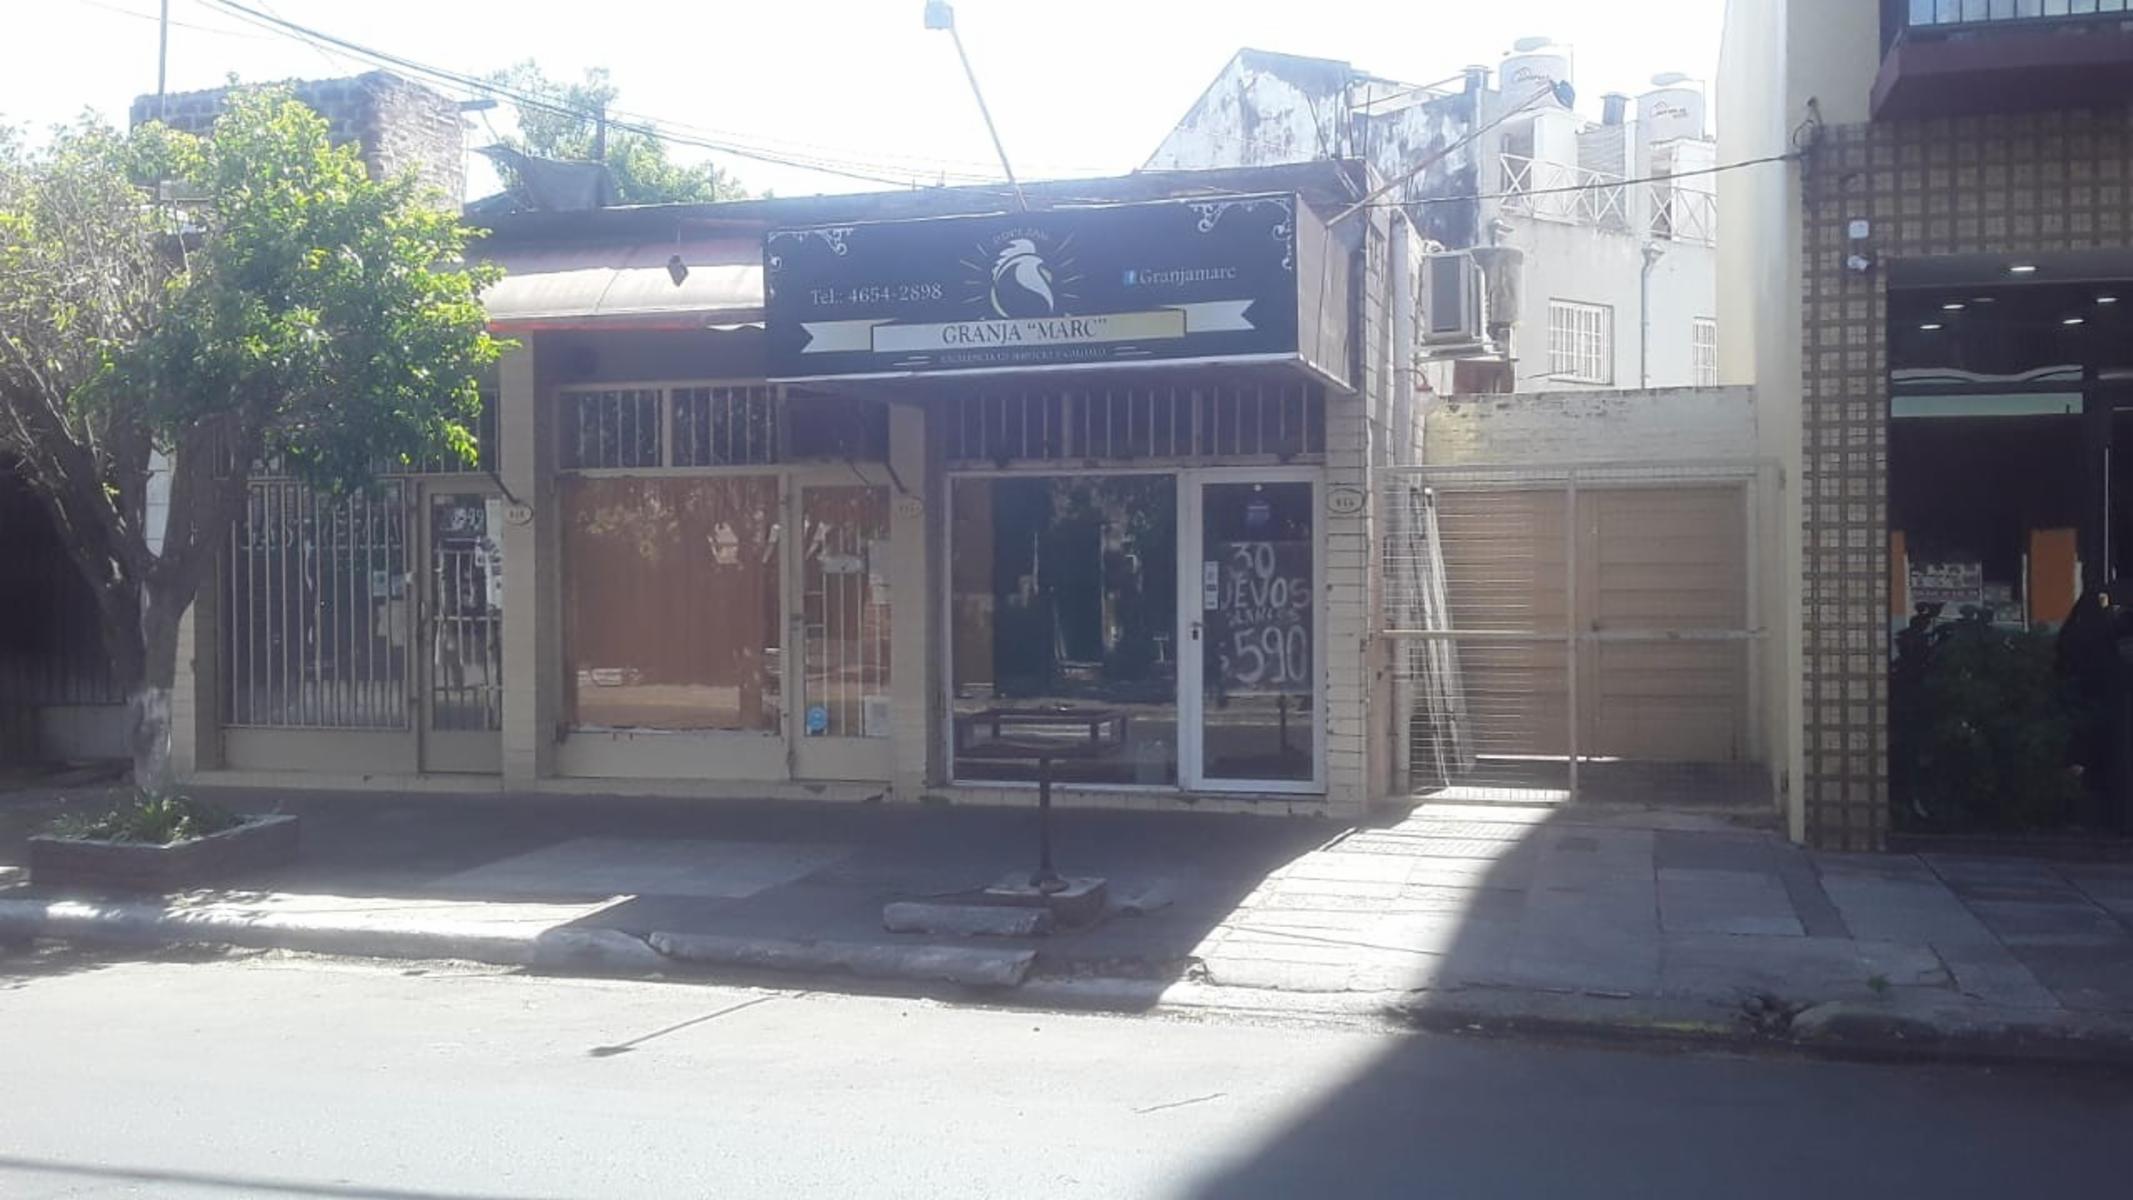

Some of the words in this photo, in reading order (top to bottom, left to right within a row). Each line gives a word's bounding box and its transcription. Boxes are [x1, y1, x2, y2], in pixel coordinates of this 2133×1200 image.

[1138, 265, 1237, 286] Granjamarc
[847, 281, 943, 304] 4654-2898
[942, 321, 1022, 344] GRANJA
[1230, 542, 1275, 580] 30
